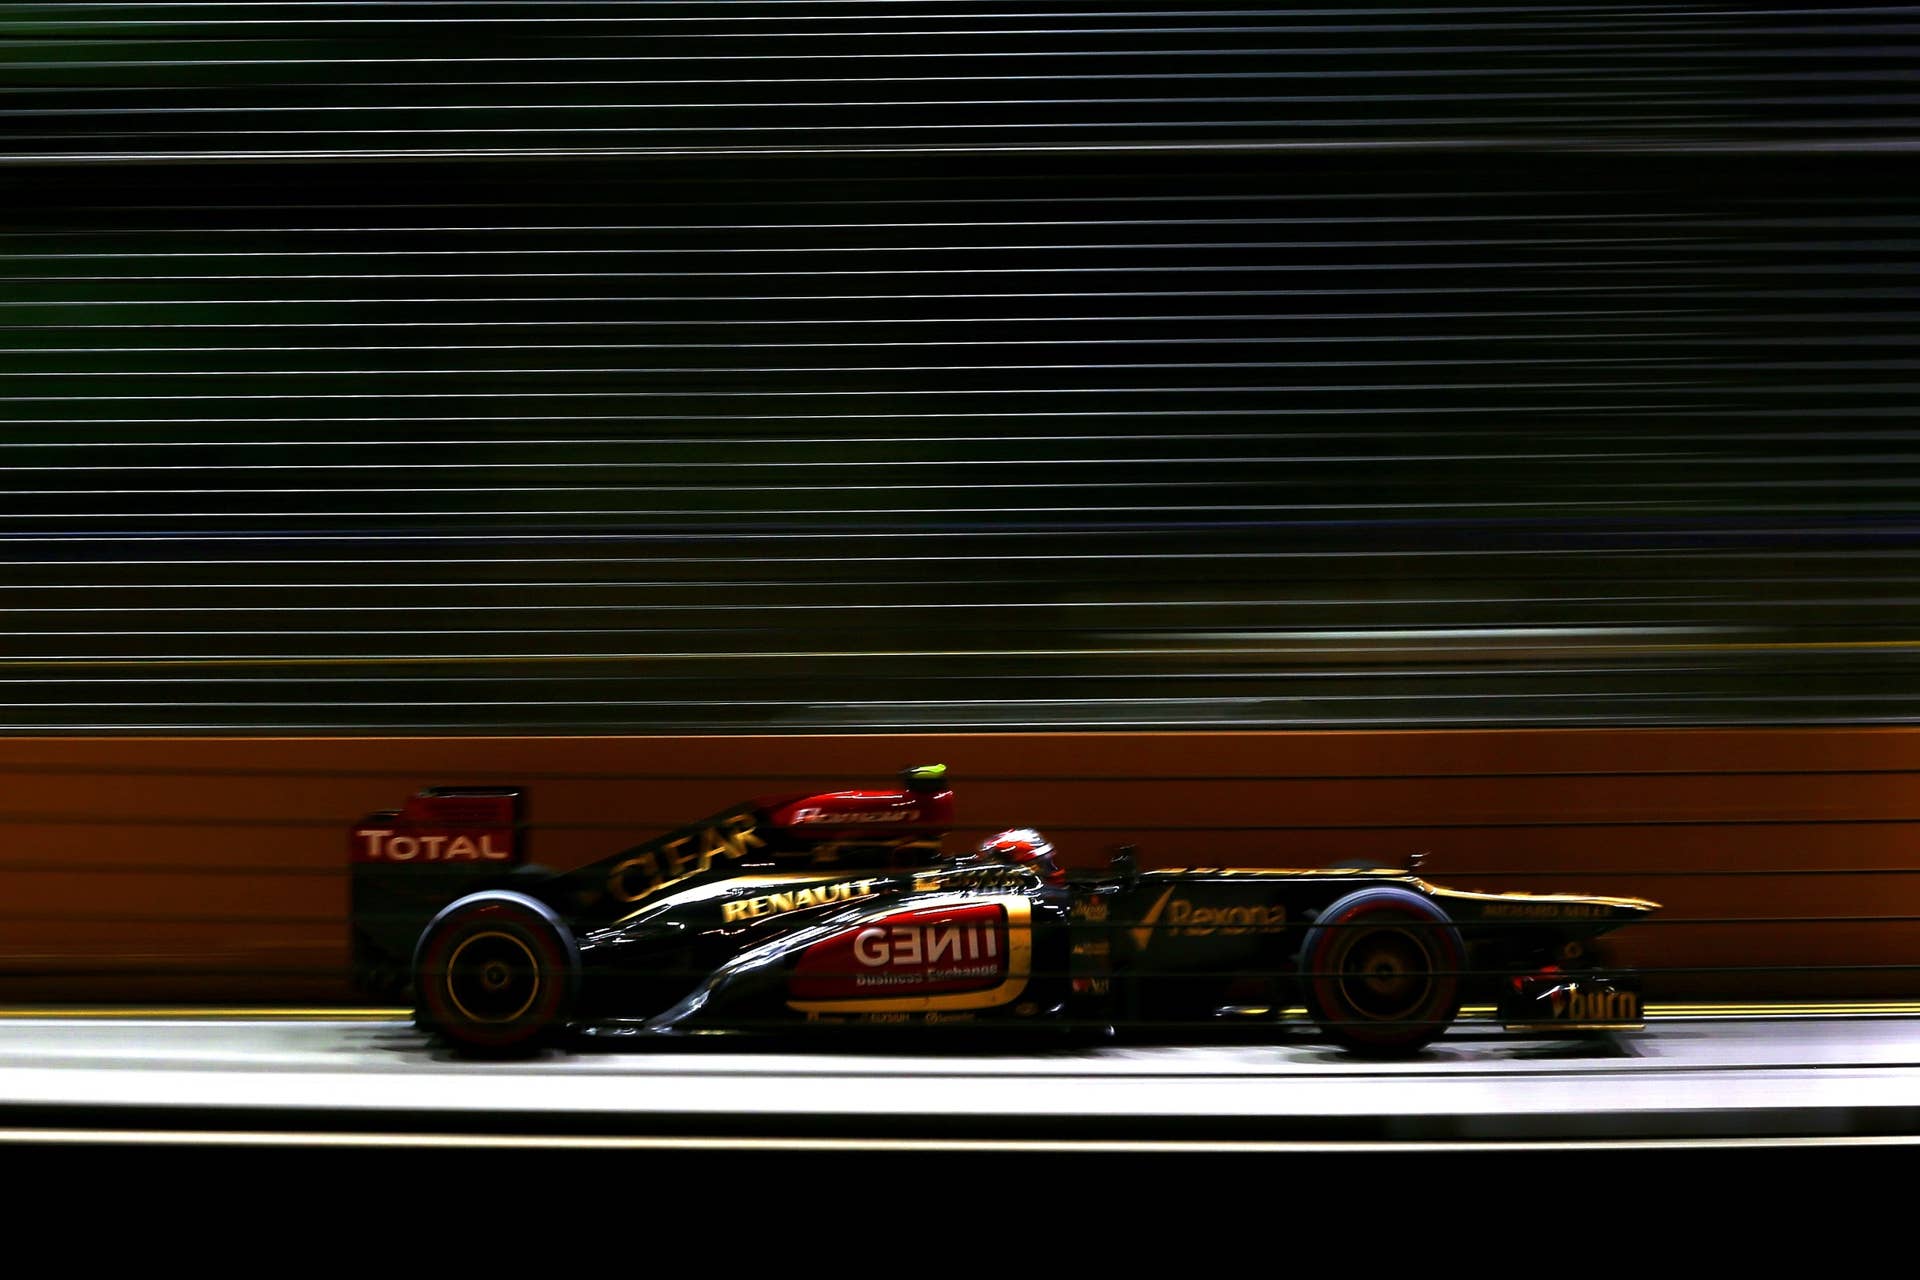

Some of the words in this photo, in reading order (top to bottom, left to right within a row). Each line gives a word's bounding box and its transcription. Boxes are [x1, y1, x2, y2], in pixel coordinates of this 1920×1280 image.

[355, 829, 509, 860] TOTAL
[608, 811, 768, 903] CLEAR
[721, 877, 876, 923] RENAULT
[1167, 898, 1288, 936] Rexona
[1568, 988, 1639, 1018] burn
